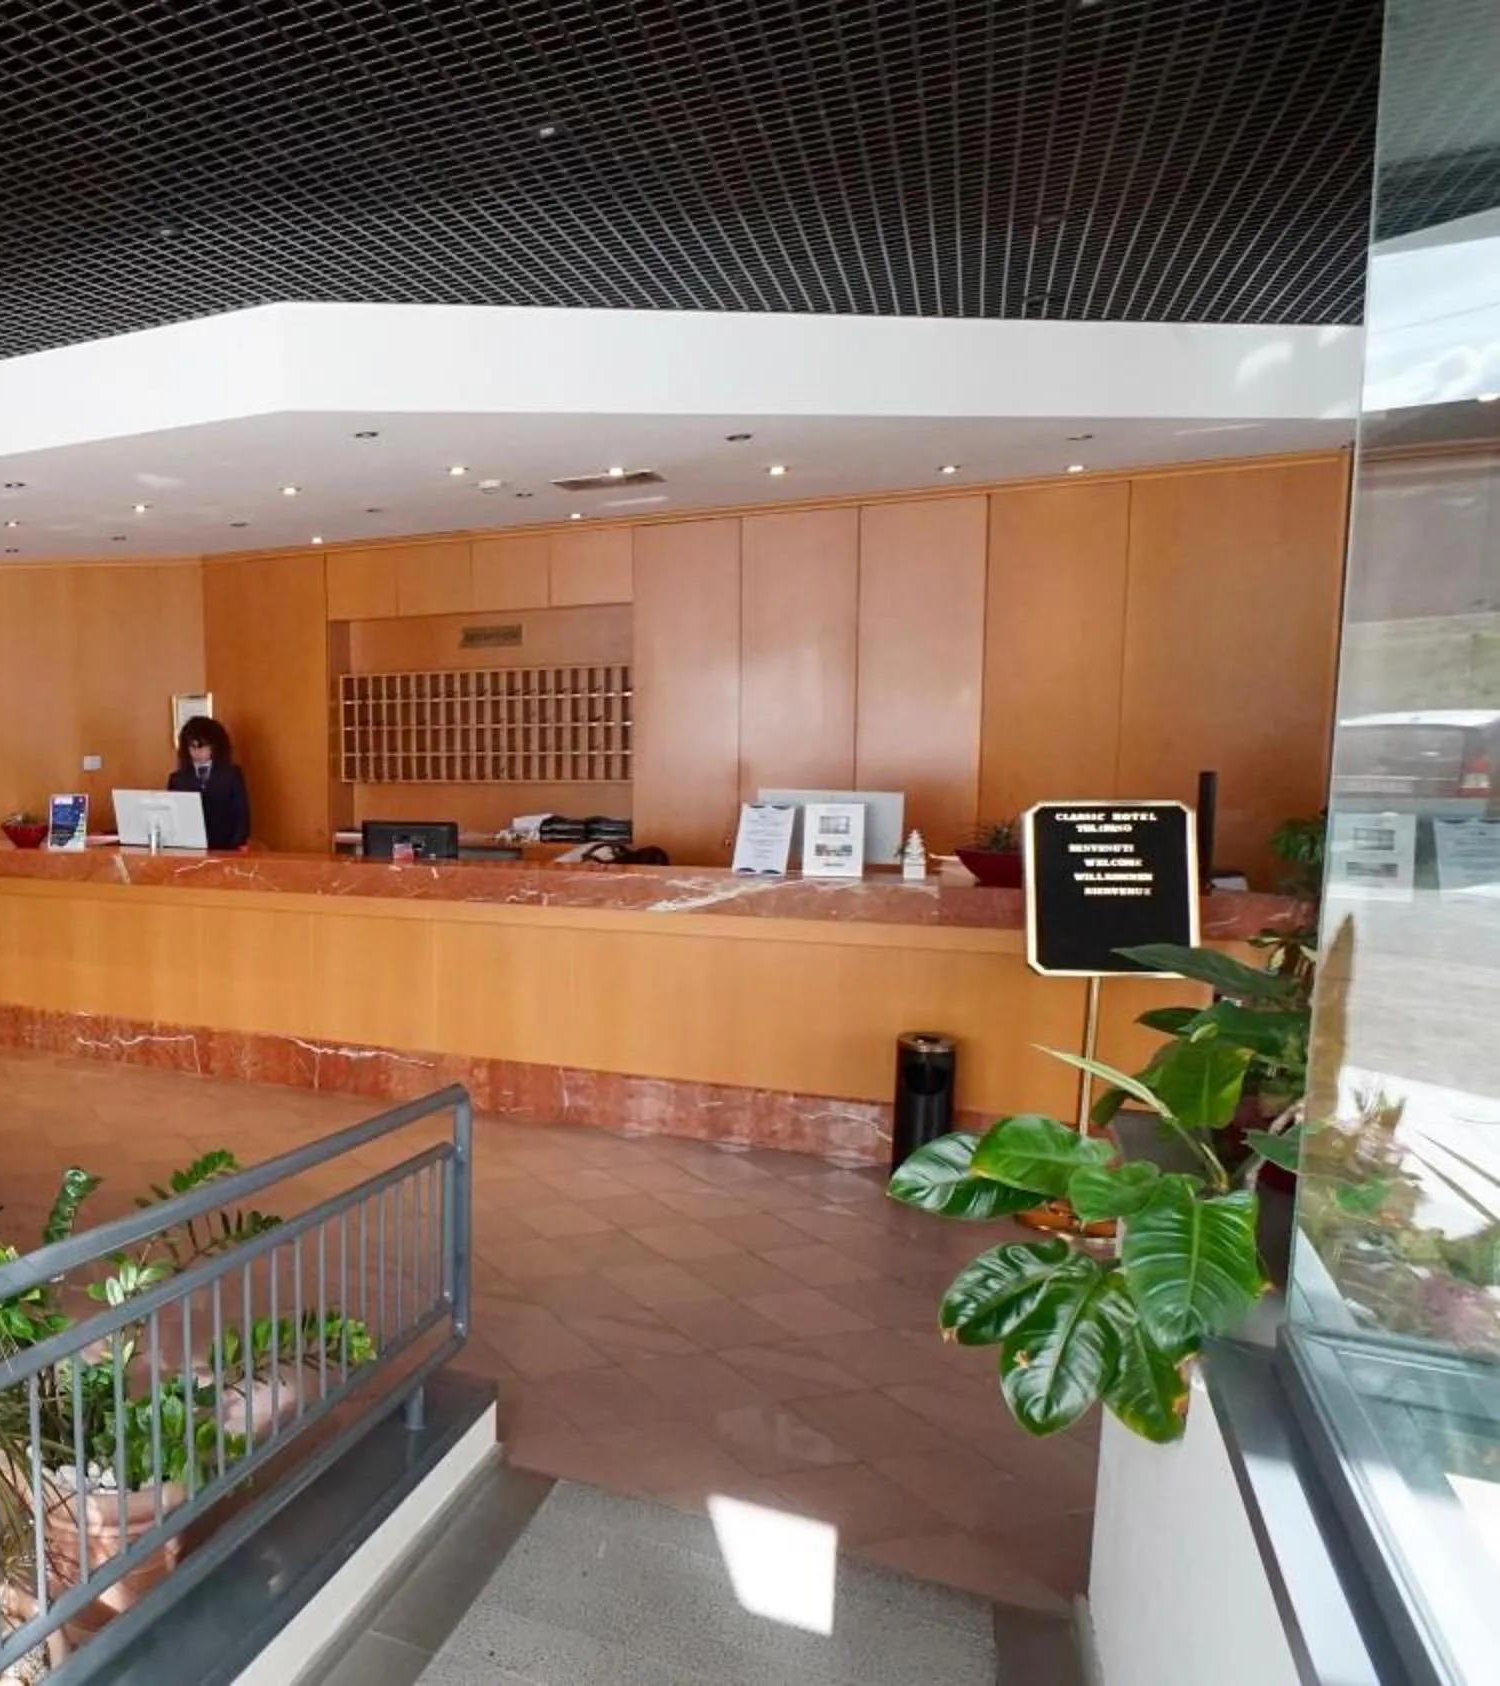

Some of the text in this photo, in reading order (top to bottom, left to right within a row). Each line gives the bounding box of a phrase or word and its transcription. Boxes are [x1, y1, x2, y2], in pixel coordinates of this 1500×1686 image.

[1055, 811, 1158, 821] CLASSIC HOTEL
[1068, 843, 1135, 853] BENVENUTI
[1083, 858, 1143, 868] WELCOME
